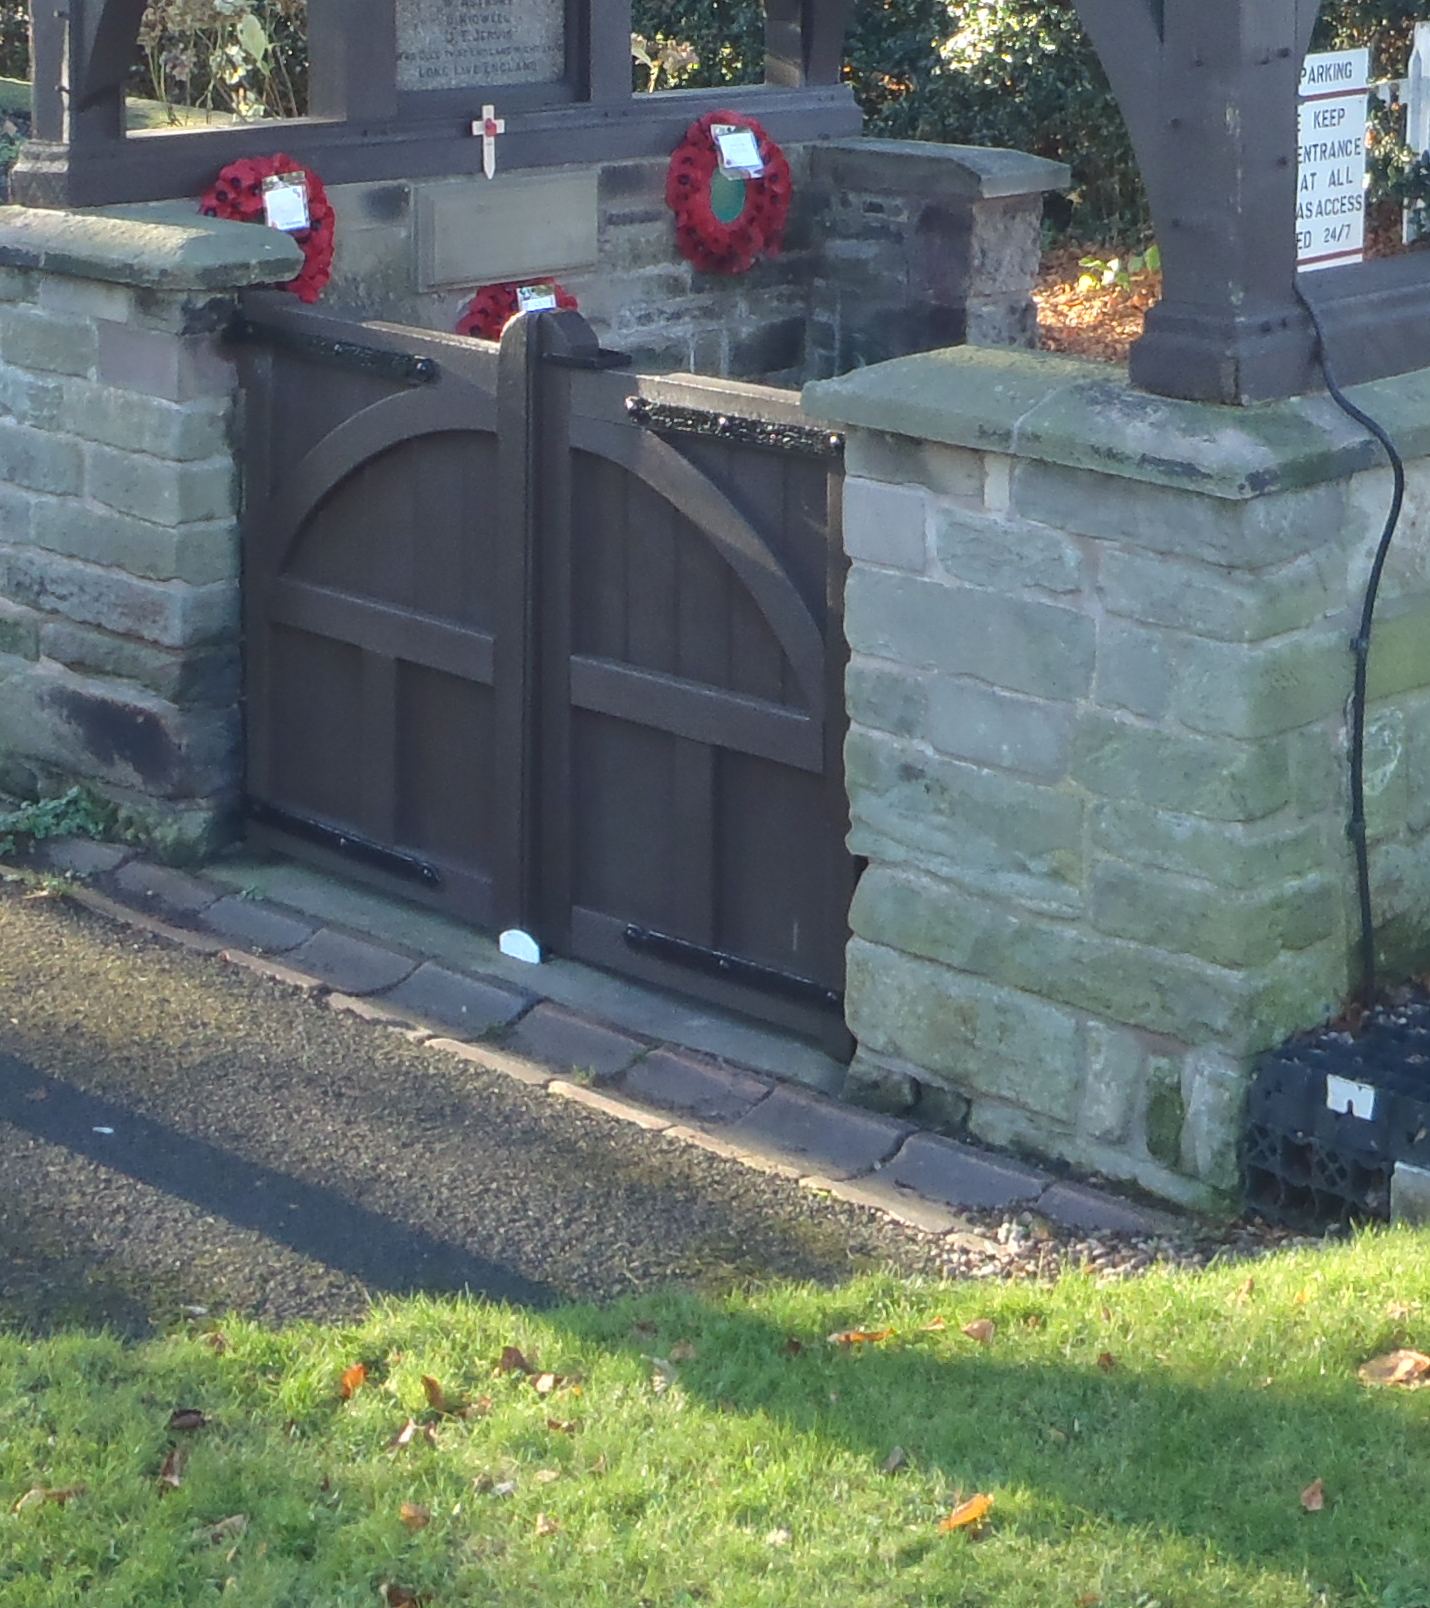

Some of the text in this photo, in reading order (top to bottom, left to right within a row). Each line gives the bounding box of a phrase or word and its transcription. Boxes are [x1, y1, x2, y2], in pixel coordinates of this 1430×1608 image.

[1300, 61, 1353, 85] PARKING
[1313, 107, 1346, 130] KEEP
[1298, 138, 1361, 165] ENTRANCE
[1300, 166, 1354, 193] AT ALL
[1315, 194, 1363, 218] ACCESS
[1323, 223, 1352, 244] 24/7
